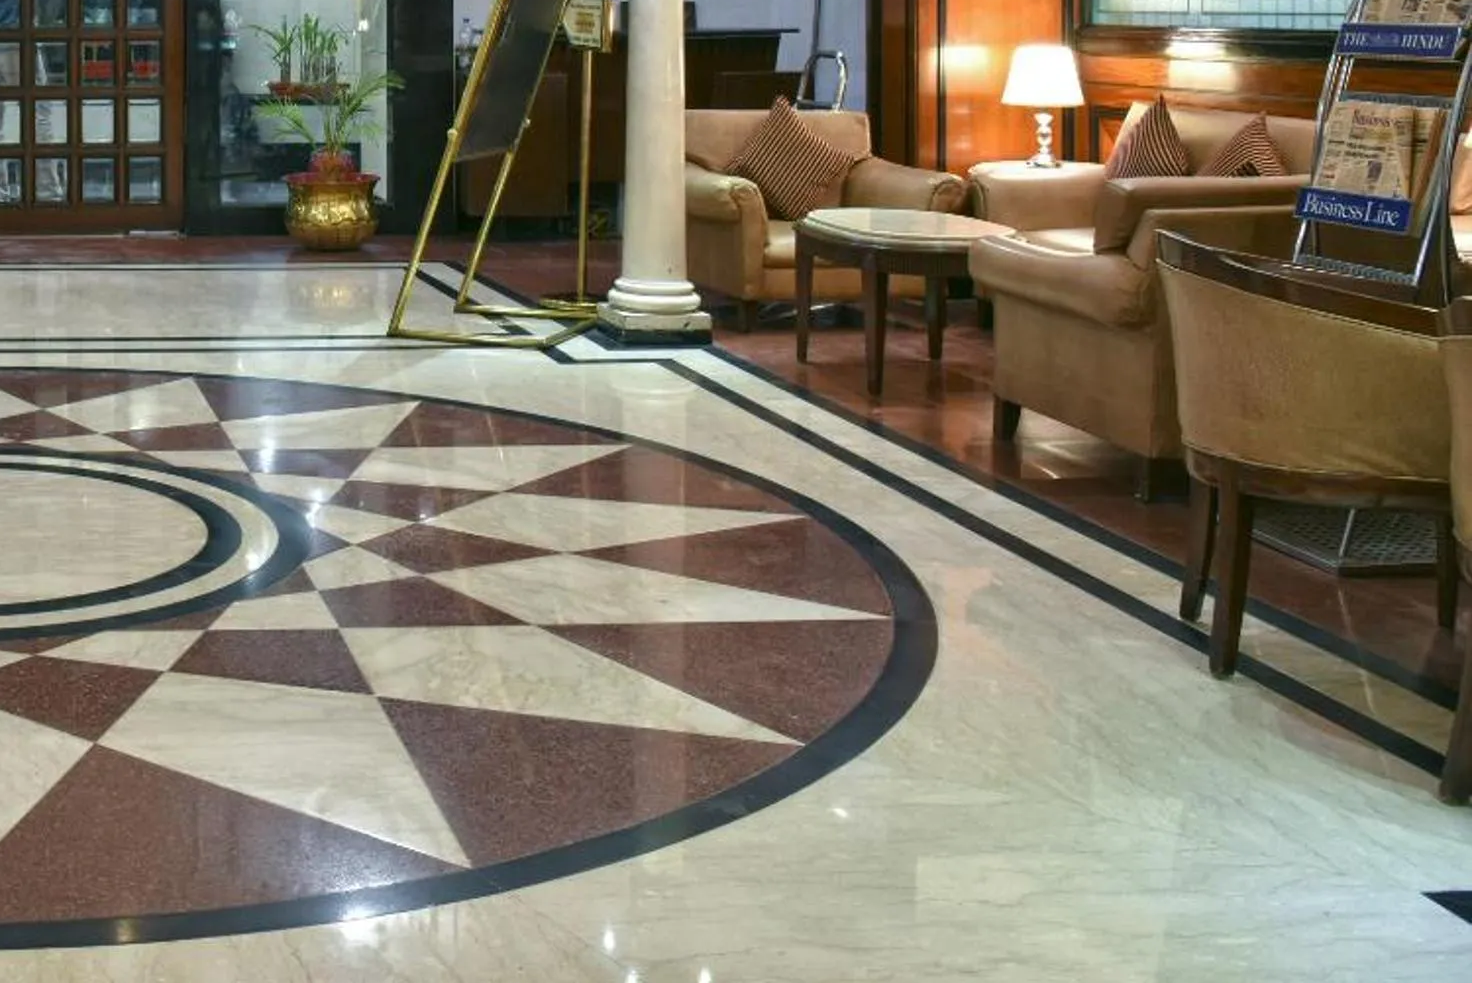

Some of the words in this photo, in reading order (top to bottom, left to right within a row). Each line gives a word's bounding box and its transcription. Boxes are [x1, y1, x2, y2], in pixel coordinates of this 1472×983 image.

[1343, 31, 1369, 47] THE
[1400, 33, 1445, 50] HINDU
[1302, 193, 1364, 220] Business
[1364, 201, 1401, 227] Line
